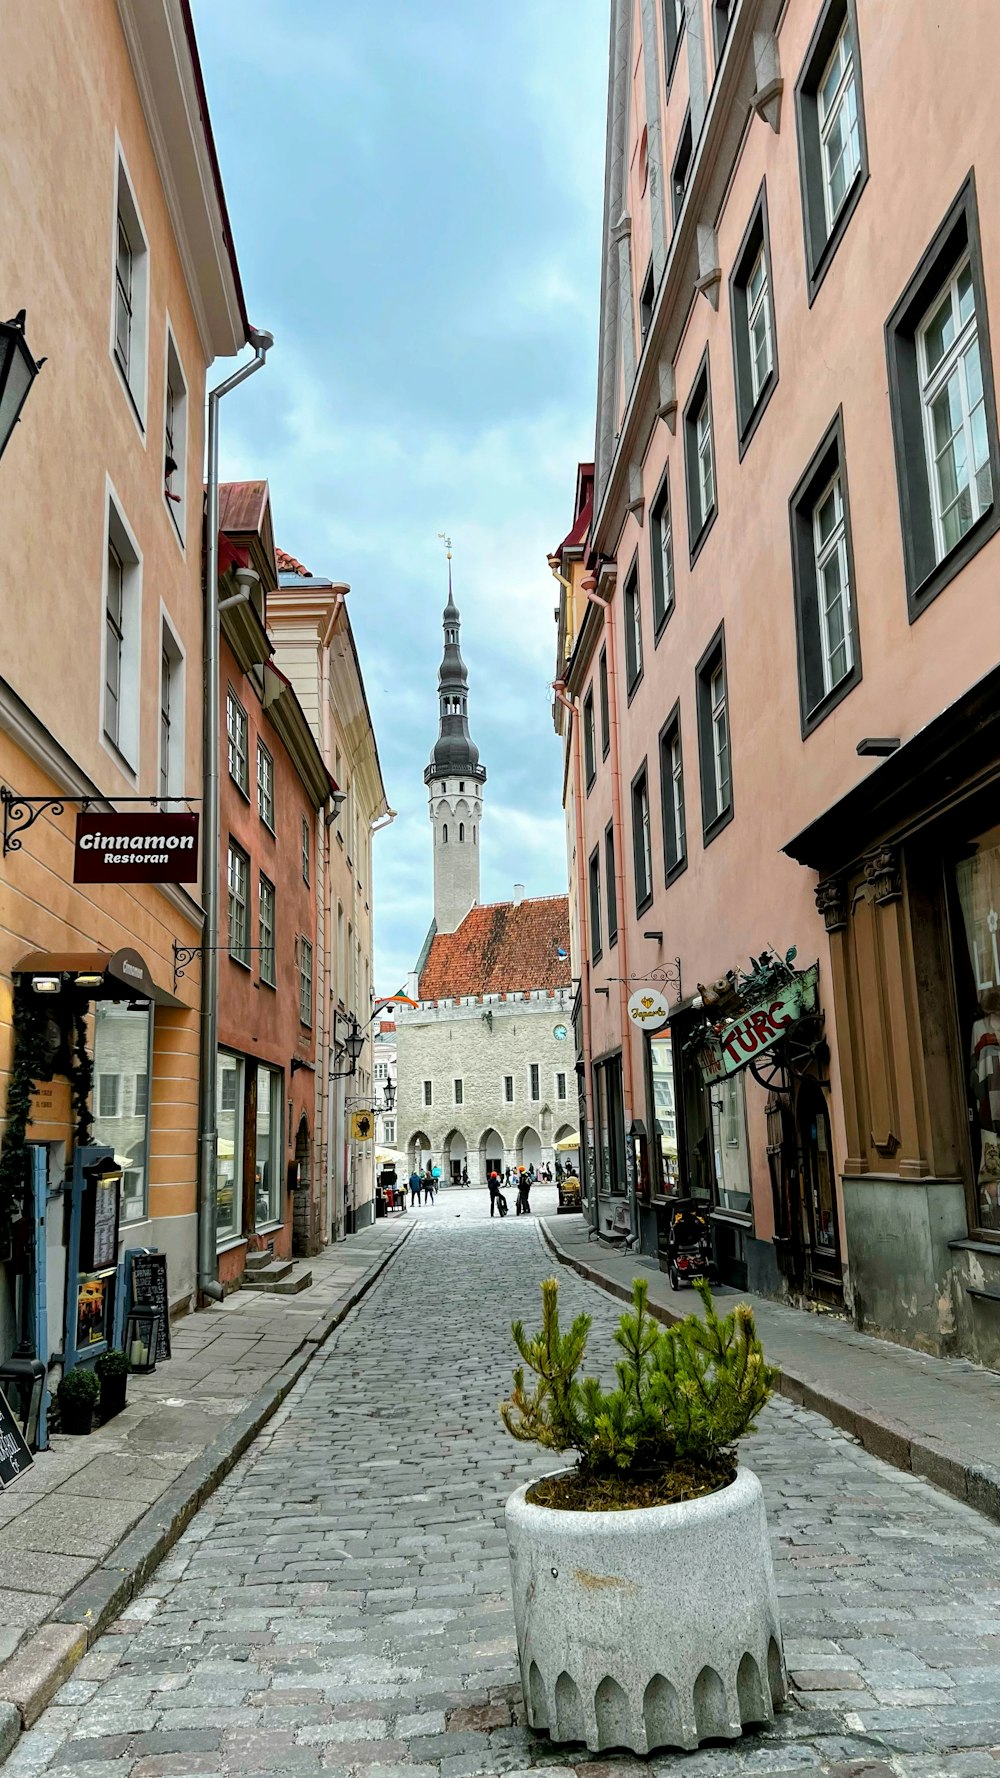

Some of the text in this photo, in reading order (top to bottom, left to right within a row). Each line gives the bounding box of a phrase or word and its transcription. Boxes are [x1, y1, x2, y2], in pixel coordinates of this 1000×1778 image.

[80, 832, 194, 849] Cinnamon
[104, 853, 169, 864] Restoran
[722, 1001, 793, 1064] TURG
